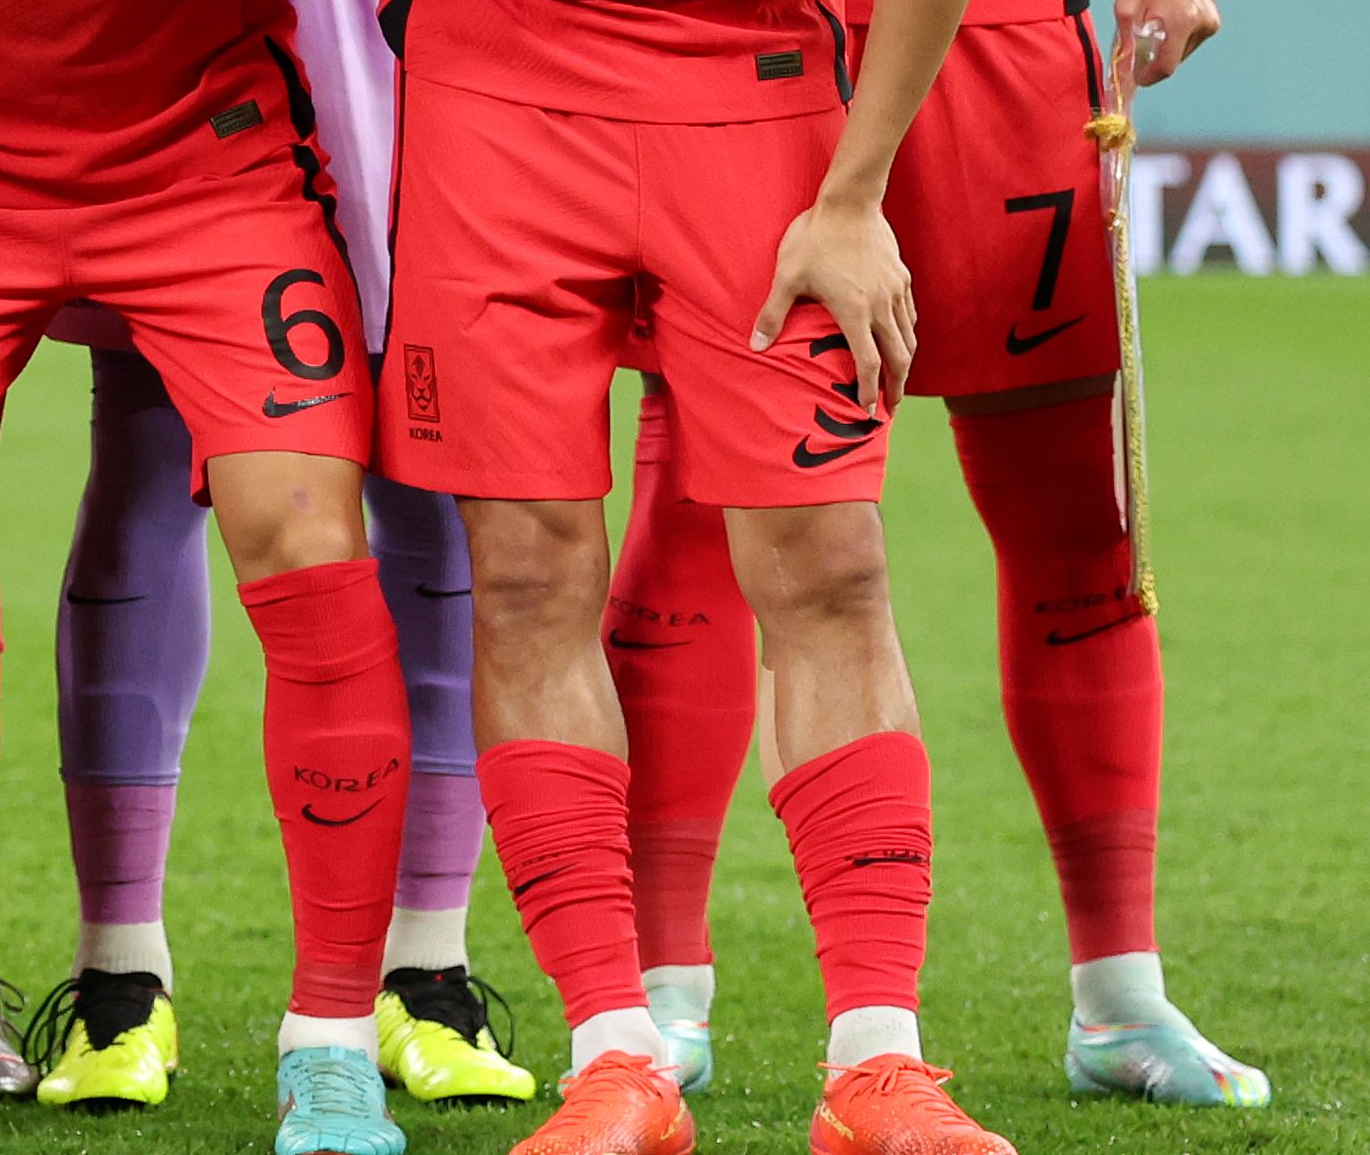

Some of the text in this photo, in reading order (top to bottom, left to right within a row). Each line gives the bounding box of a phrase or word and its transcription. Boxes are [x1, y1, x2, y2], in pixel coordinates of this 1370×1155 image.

[1004, 188, 1075, 312] 7
[262, 268, 346, 381] 6
[409, 428, 443, 443] KOREA
[609, 595, 711, 627] KOREA
[293, 757, 400, 793] KOREA
